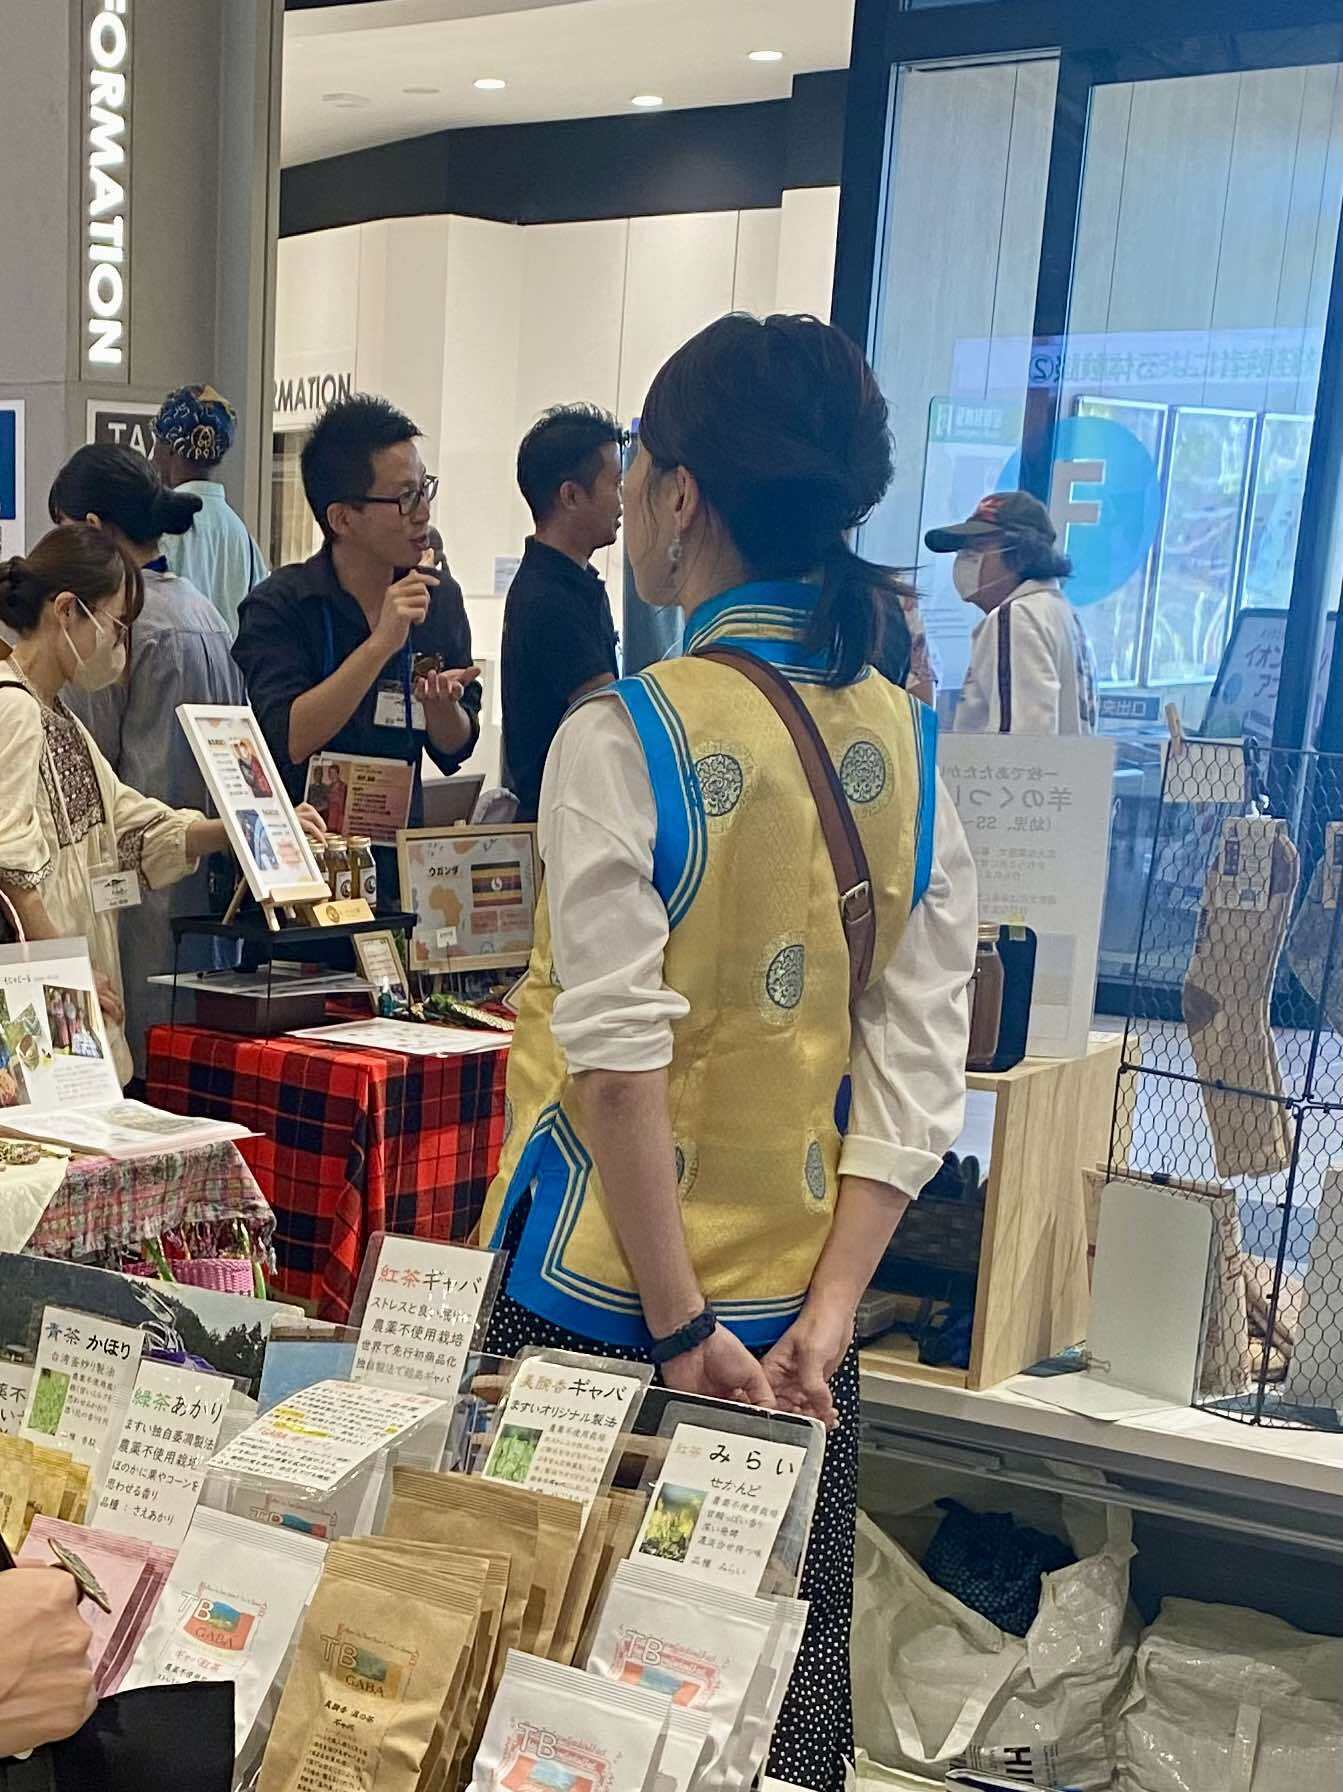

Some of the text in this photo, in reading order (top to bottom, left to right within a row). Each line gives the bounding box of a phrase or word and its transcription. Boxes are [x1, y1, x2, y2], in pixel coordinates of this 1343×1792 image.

[378, 1265, 483, 1294] 紅茶ギャバ
[371, 1318, 464, 1347] 農薬不使用栽培
[86, 1335, 131, 1360] かほり
[568, 1377, 627, 1401] ギャバ
[132, 1387, 224, 1424] 緑茶あかり
[117, 1438, 202, 1470] 農薬不使用栽培
[709, 1444, 794, 1475] みらい
[104, 1478, 159, 1501] 思わせる香り
[710, 1477, 762, 1497] せかんど
[345, 1675, 386, 1697] GABA
